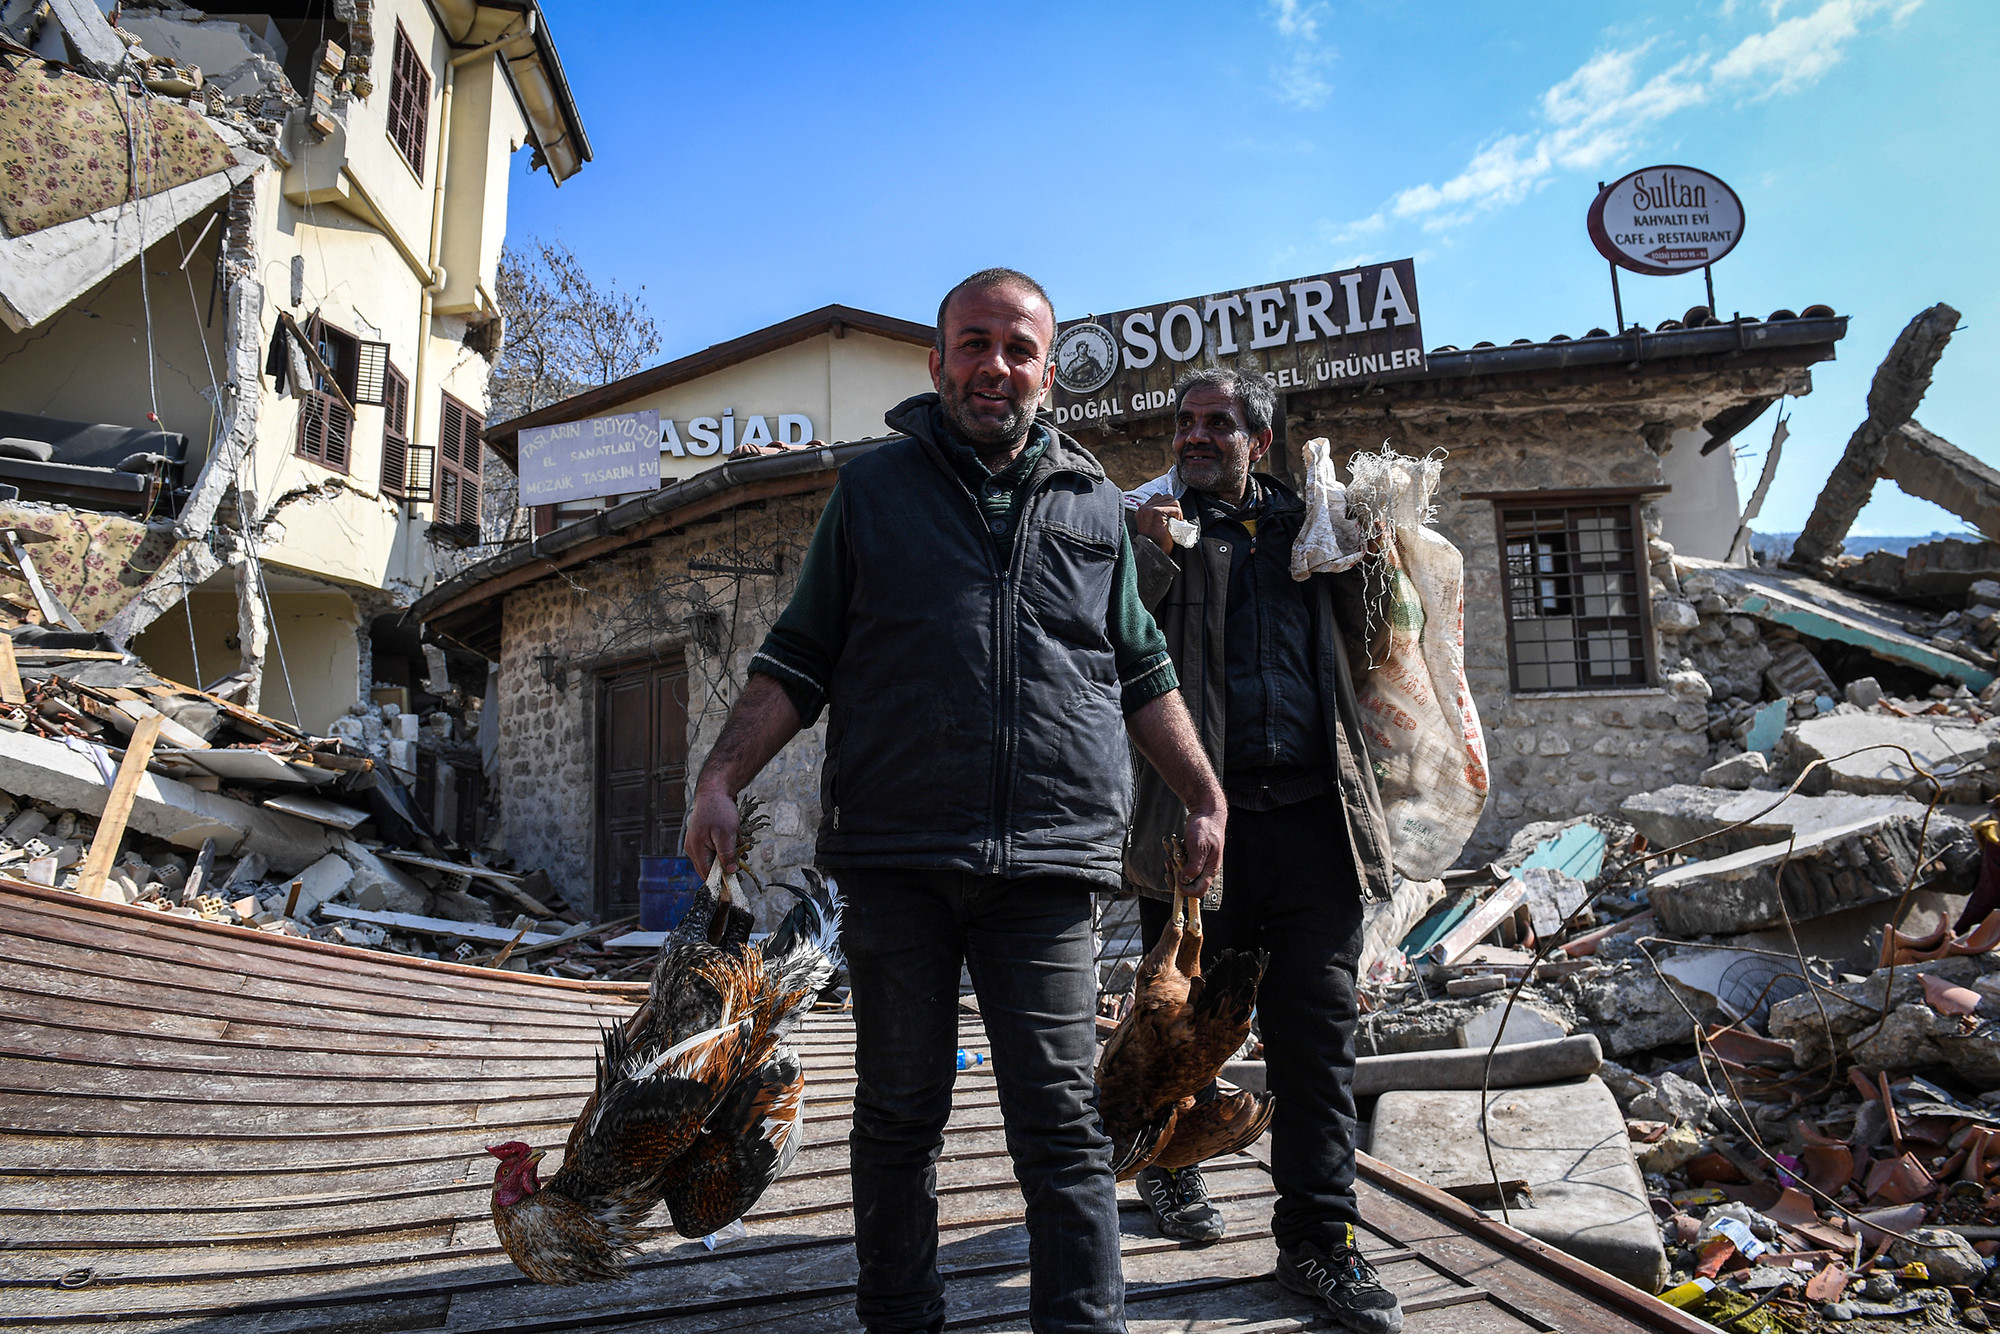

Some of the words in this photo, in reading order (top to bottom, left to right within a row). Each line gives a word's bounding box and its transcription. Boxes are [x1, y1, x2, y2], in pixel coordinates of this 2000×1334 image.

[1633, 172, 1707, 211] Sultan
[1615, 233, 1645, 245] CAFE
[1657, 230, 1732, 244] RESTAURANT
[1633, 214, 1689, 227] KAHVALTI
[1692, 211, 1710, 225] EVİ
[1122, 267, 1416, 370] SOTERIA
[1056, 396, 1124, 425] DOĞAL
[1131, 387, 1177, 412] GIDA
[1315, 347, 1421, 382] ÜRÜNLER
[520, 423, 580, 459] TAŞLARIN
[593, 418, 659, 449] BÜYÜSÜ
[543, 457, 556, 467] EL
[570, 441, 636, 461] SANATLARI
[526, 473, 574, 494] MOZAİK
[582, 465, 635, 485] TASARIM
[639, 458, 659, 477] EVİ
